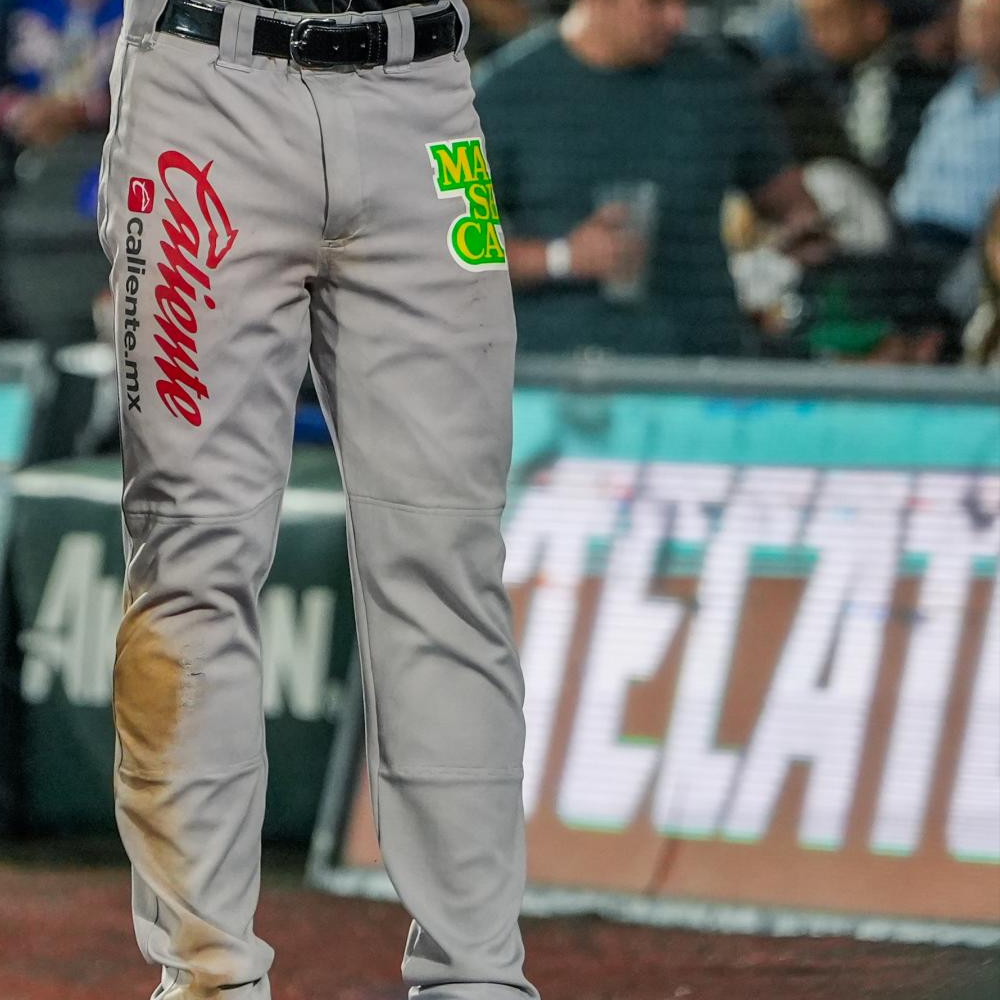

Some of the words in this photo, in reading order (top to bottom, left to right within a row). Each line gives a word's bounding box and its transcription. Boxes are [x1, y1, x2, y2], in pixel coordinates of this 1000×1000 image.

[437, 145, 489, 186] MA
[155, 150, 239, 427] Caliente
[456, 221, 505, 260] CA
[124, 217, 147, 413] caliente.mx
